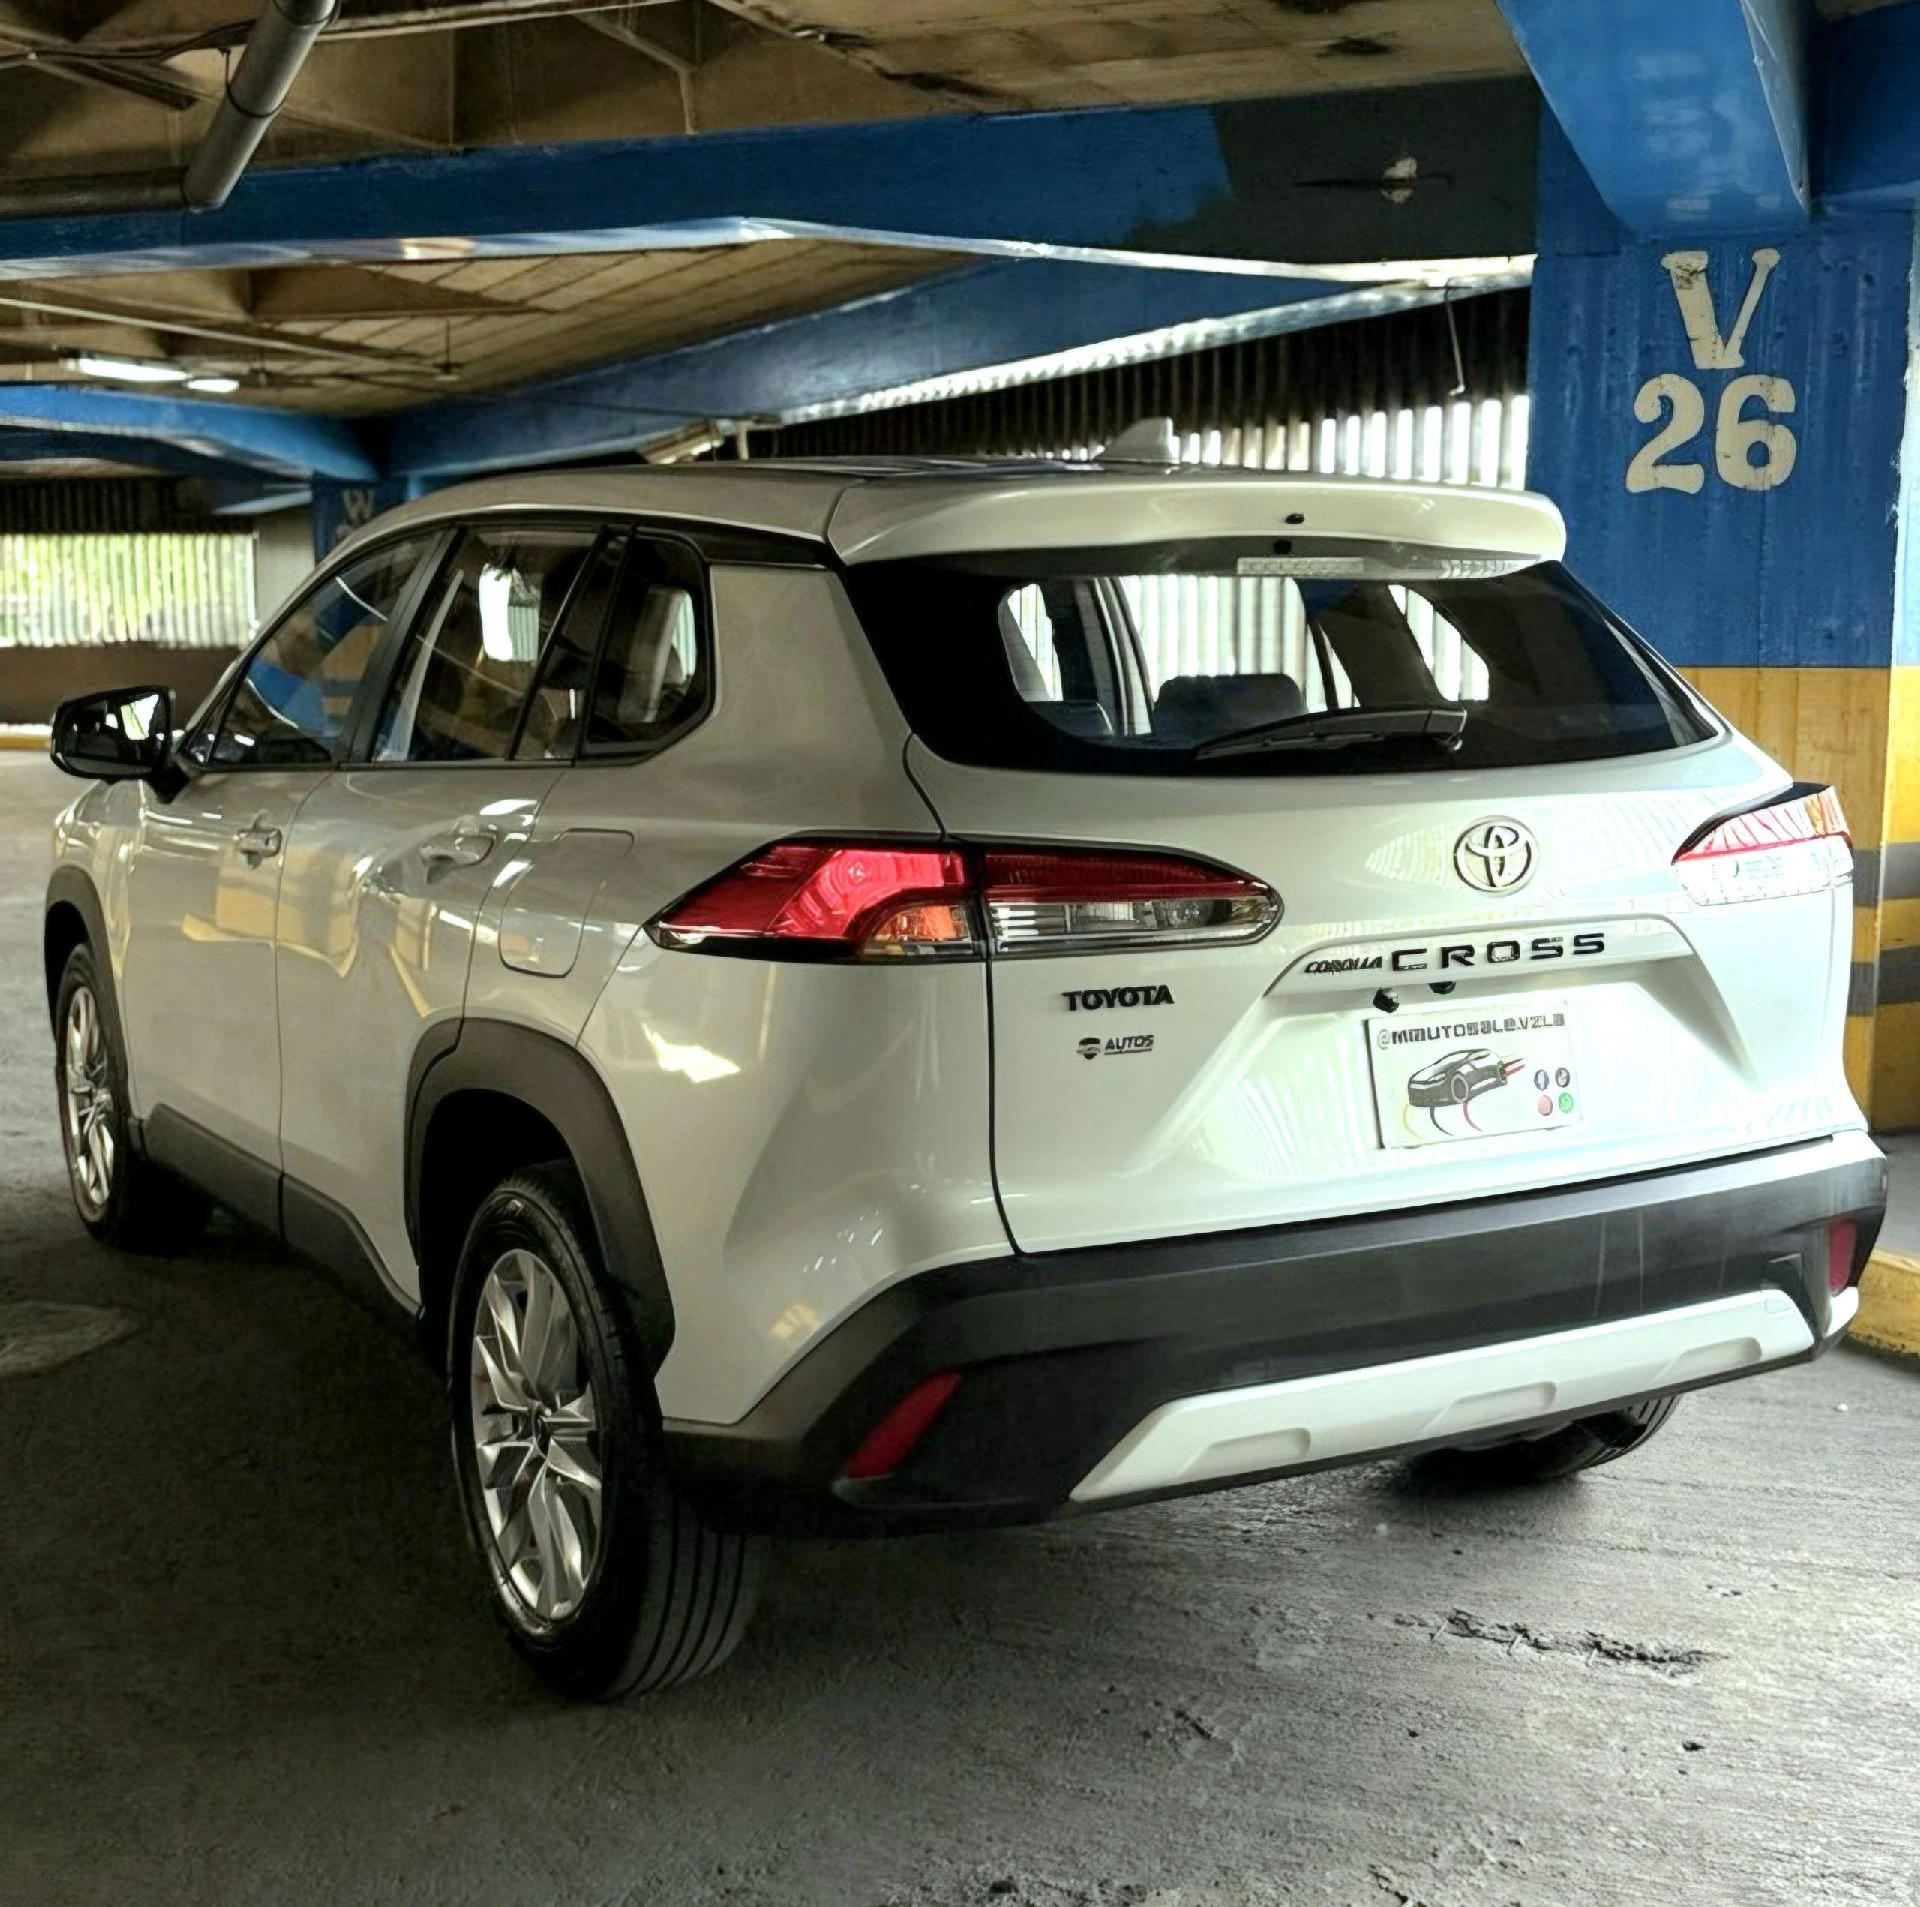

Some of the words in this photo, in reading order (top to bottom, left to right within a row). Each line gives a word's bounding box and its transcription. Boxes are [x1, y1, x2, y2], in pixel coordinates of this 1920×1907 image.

[1661, 248, 1781, 369] V
[1626, 373, 1796, 495] 26
[1304, 956, 1383, 974] COROLLA
[1391, 932, 1605, 972] CROSS
[1061, 985, 1175, 1011] TOYOTA
[1104, 1034, 1154, 1051] AUTOS
